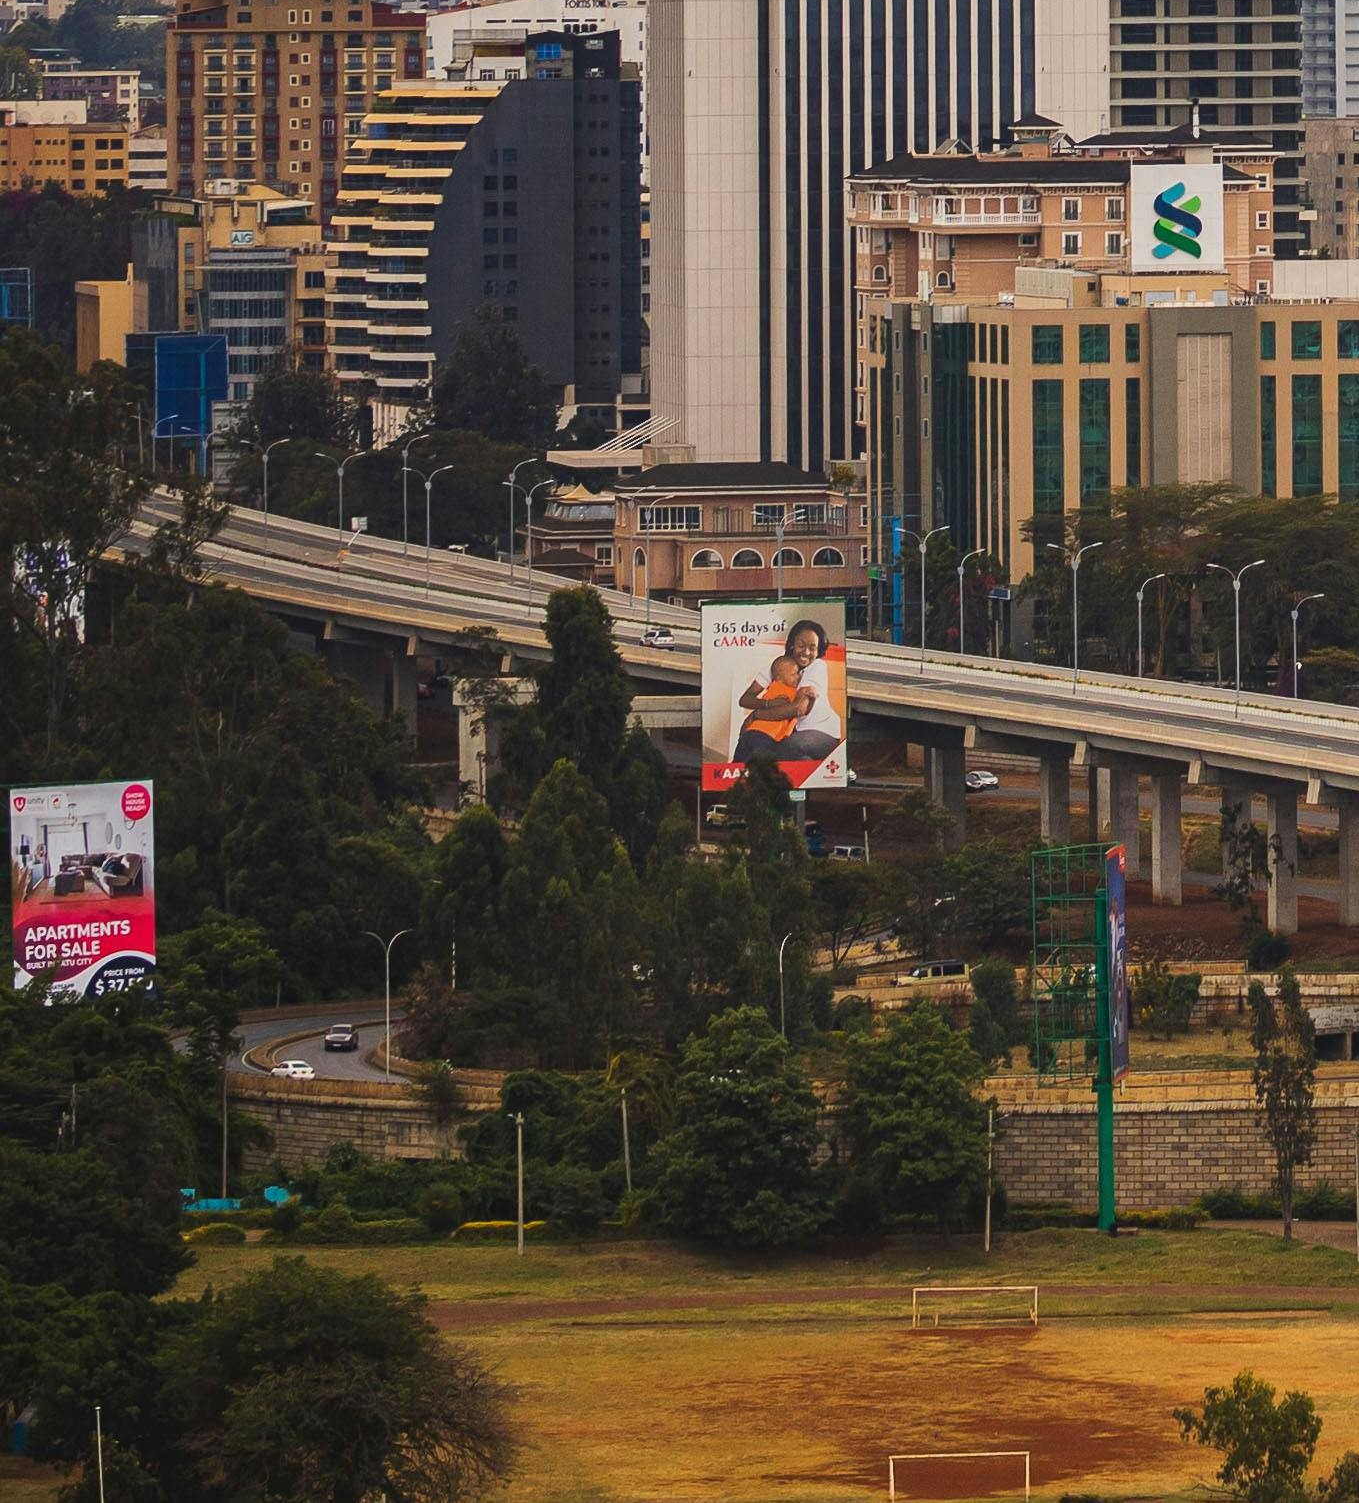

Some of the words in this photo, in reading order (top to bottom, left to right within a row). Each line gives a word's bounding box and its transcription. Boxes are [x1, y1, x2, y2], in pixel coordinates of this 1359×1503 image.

[565, 0, 591, 9] FORTIS
[232, 233, 253, 243] AIG
[713, 622, 737, 634] 365
[741, 620, 769, 636] days
[772, 619, 786, 632] of
[713, 636, 756, 647] cAARe
[24, 920, 131, 943] APARTMENTS
[25, 944, 57, 961] FOR
[61, 940, 101, 958] SALE
[26, 960, 46, 970] BUILT
[77, 958, 93, 966] CITY
[103, 969, 123, 977] PRICE
[124, 967, 145, 975] FROM
